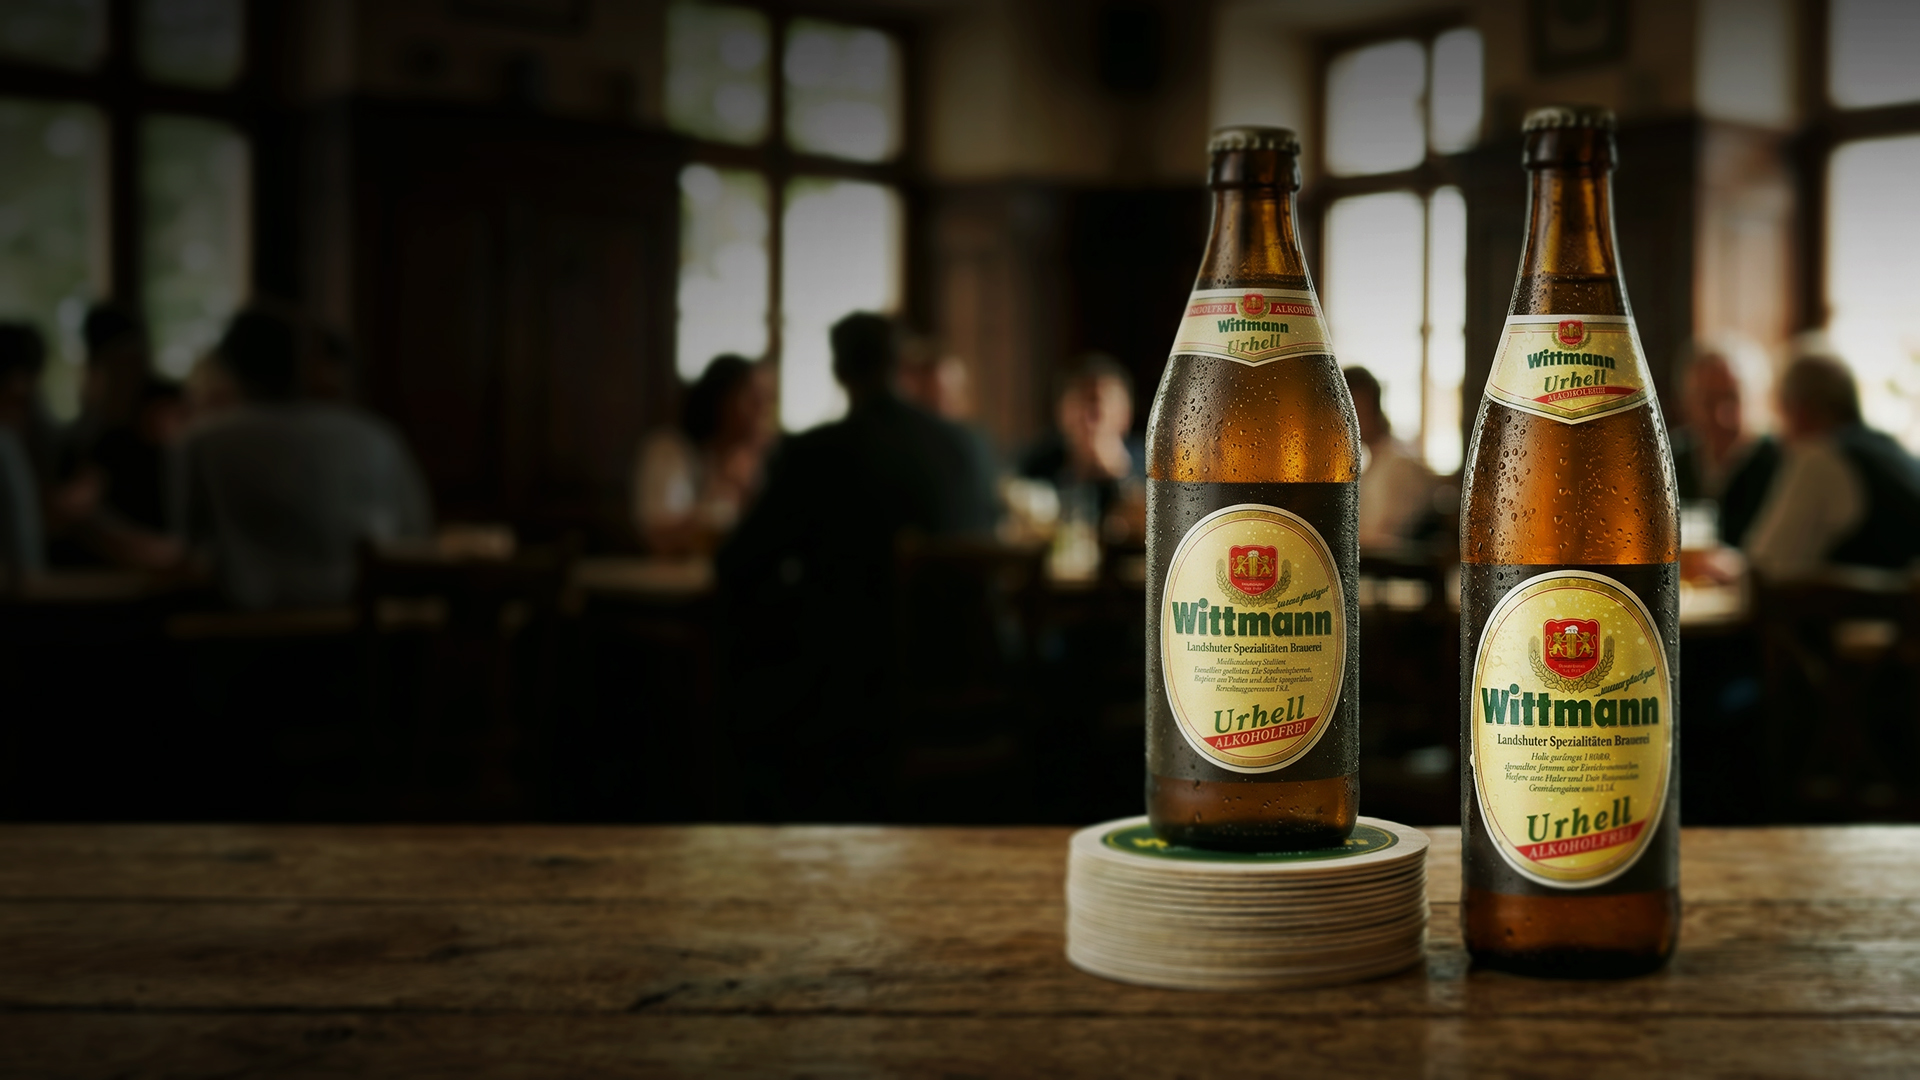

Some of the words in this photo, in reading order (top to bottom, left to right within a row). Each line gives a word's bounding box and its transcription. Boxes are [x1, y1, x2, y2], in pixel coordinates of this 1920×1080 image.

[1217, 318, 1289, 333] Wittmann
[1227, 334, 1281, 355] Urhell
[1527, 349, 1616, 370] Wittmann
[1544, 369, 1608, 393] Urhell
[1171, 598, 1332, 637] Wittmann
[1187, 641, 1231, 653] Landshuter
[1233, 642, 1289, 656] Spezialitäten
[1290, 641, 1322, 653] Brauerei
[1214, 695, 1305, 734] Urhell
[1481, 683, 1659, 728] Wittmann
[1215, 722, 1307, 748] ALKOHOLFREI
[1497, 733, 1548, 747] Landshuter
[1549, 735, 1612, 749] Spezialitäten
[1614, 733, 1650, 746] Brauerei
[1526, 796, 1632, 842] Urhell
[1528, 827, 1633, 859] ALKOHOLFREI
